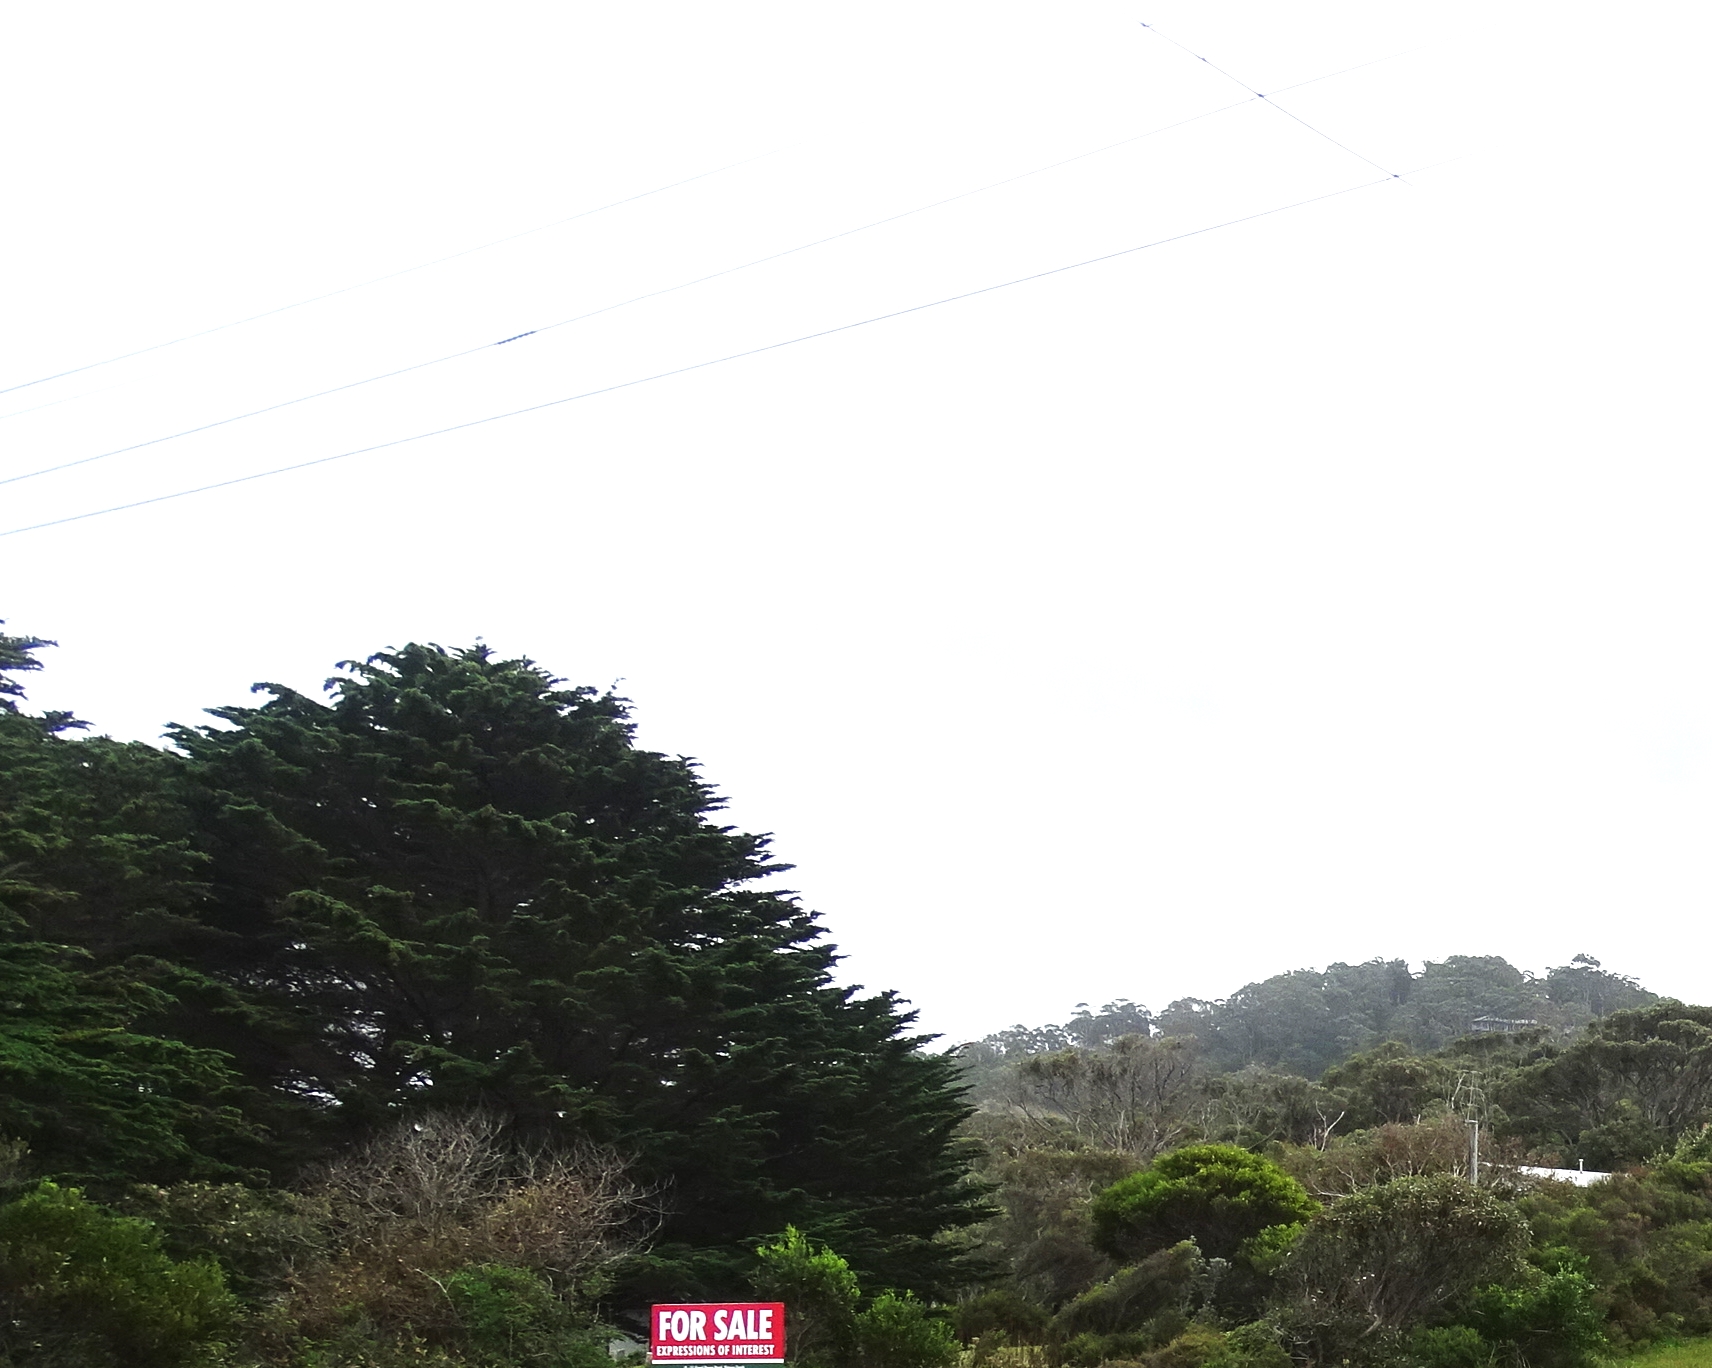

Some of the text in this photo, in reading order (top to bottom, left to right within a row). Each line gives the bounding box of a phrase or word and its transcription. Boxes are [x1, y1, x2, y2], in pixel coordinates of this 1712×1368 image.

[659, 1309, 773, 1342] FOR SALE
[656, 1344, 775, 1356] EXPRESSIONS OF INTEREST
